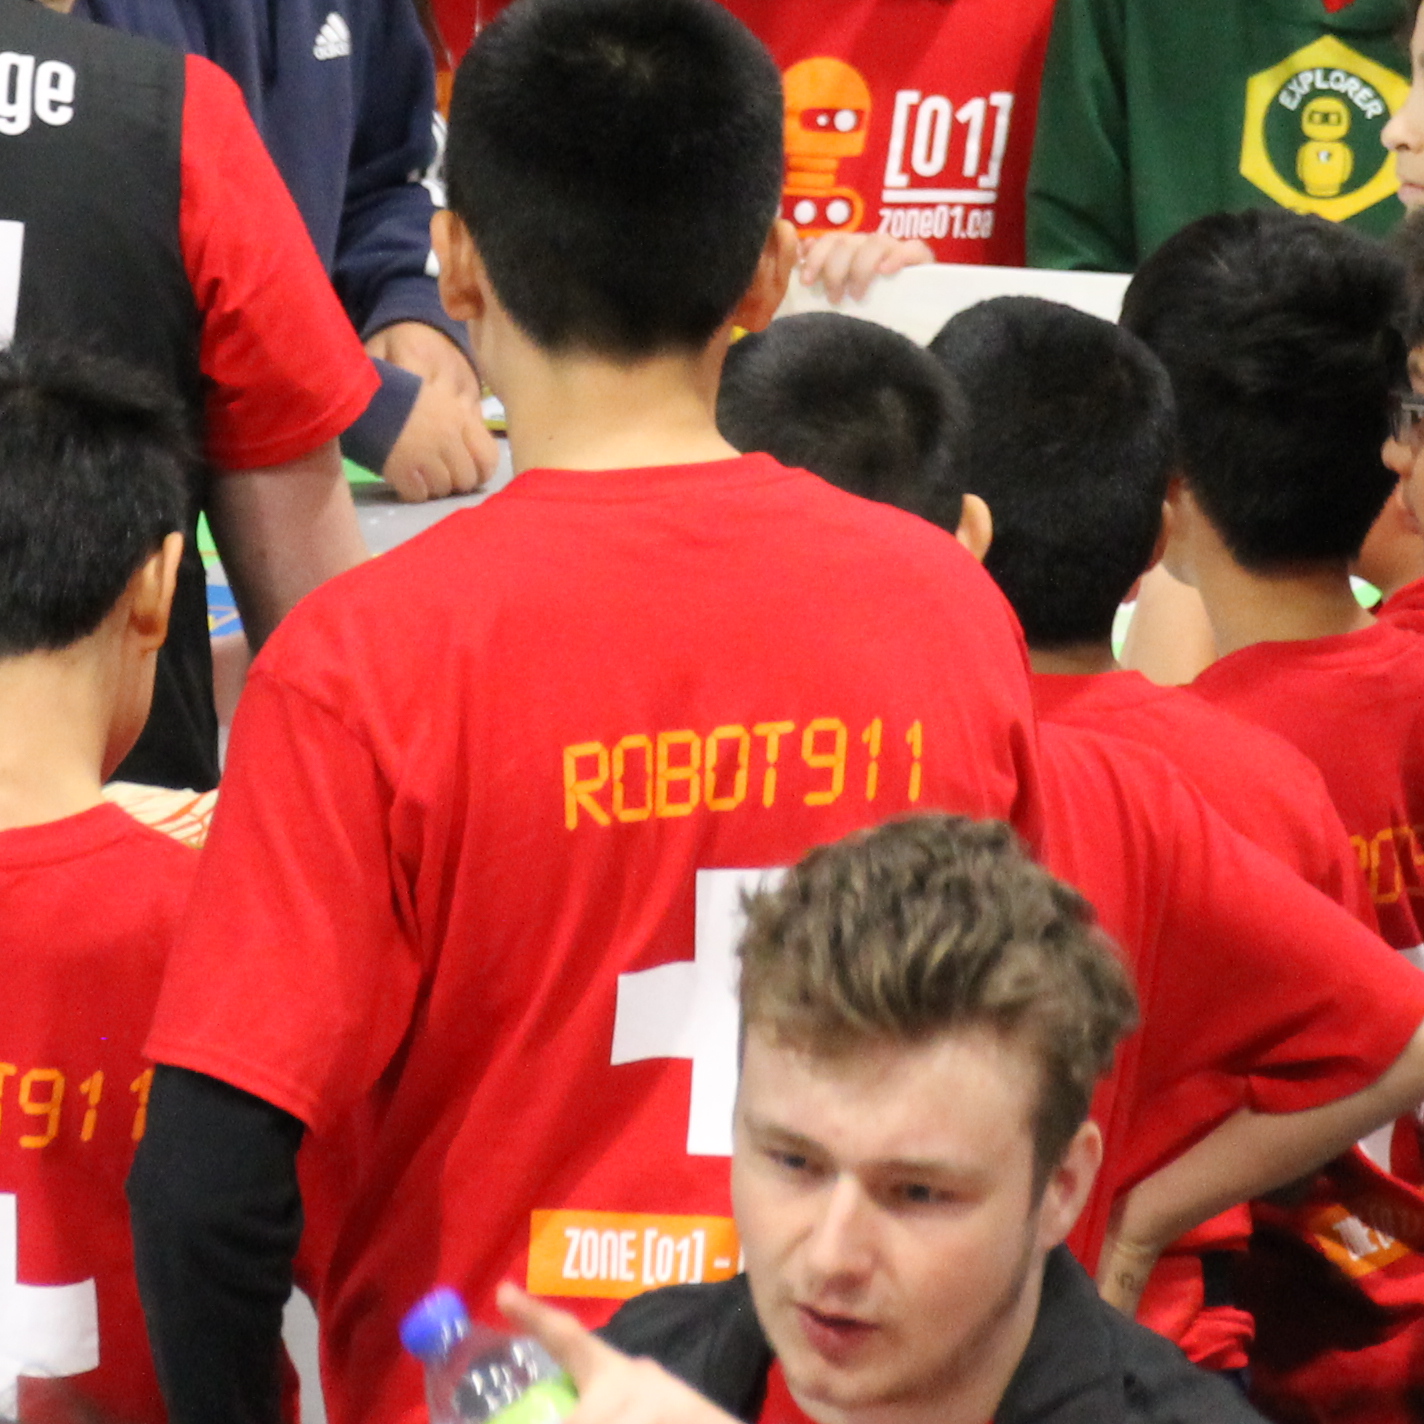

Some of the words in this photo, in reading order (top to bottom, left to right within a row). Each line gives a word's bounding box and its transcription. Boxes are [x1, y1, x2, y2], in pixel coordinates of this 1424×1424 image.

[1278, 68, 1384, 119] EXPLORER
[883, 89, 1014, 188] [01]
[563, 718, 923, 831] ROBOT911
[562, 1228, 638, 1282] ZONE
[641, 1228, 706, 1285] [01]
